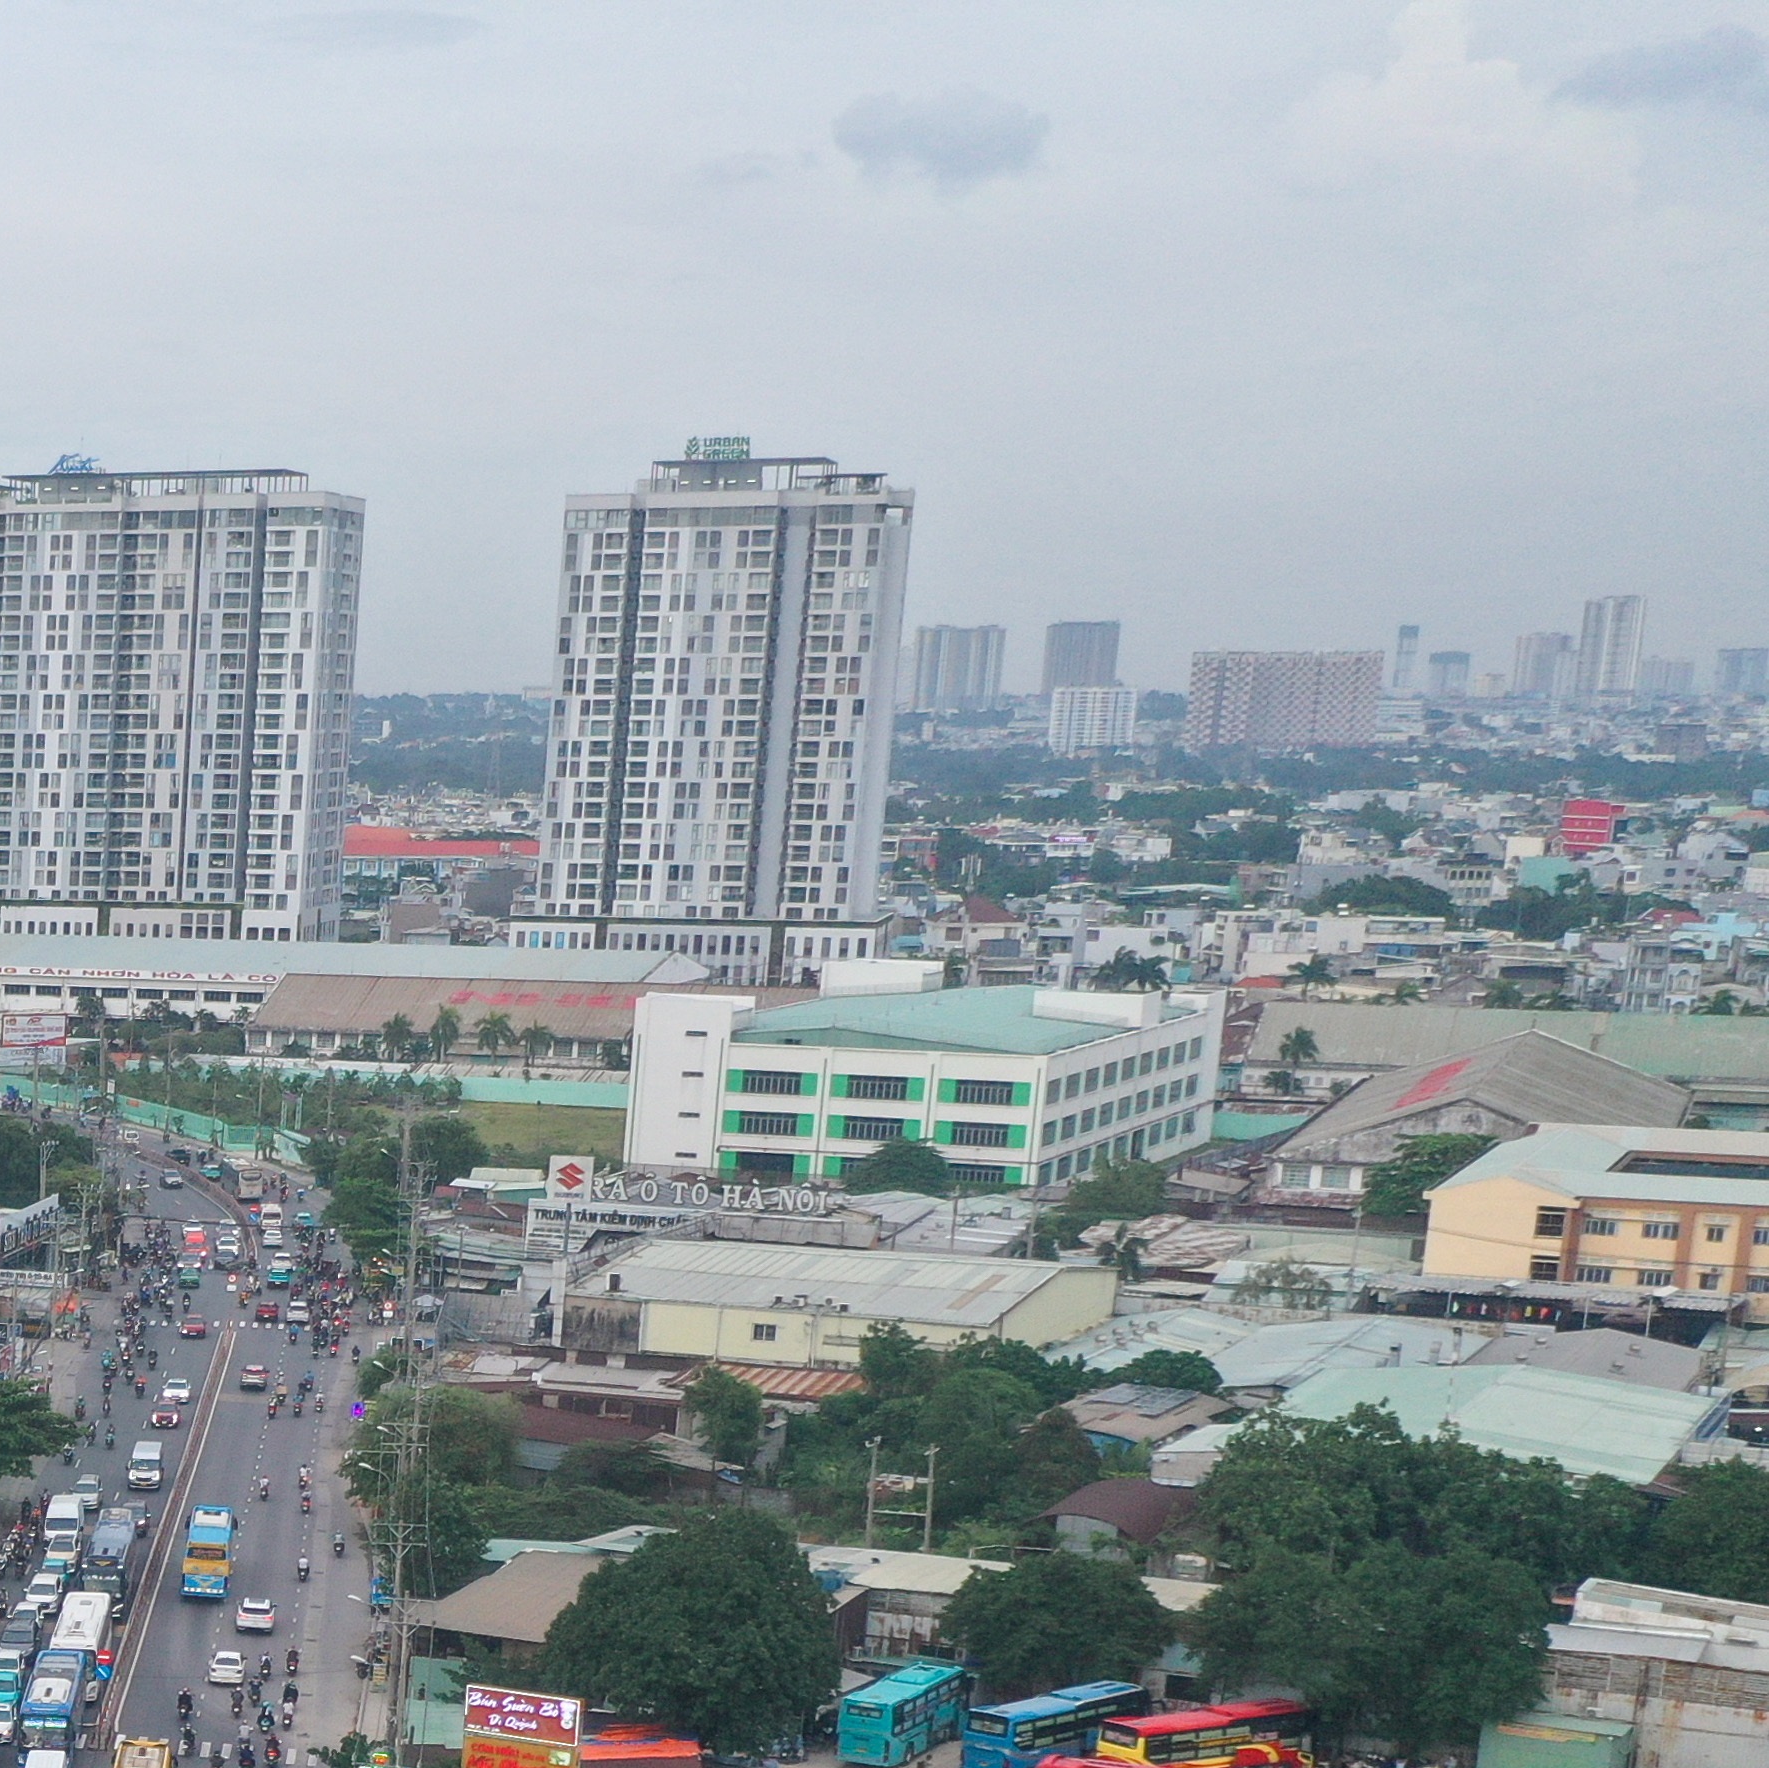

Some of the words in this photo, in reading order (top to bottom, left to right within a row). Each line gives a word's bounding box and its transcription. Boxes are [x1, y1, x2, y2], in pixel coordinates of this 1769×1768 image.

[29, 967, 70, 976] CÂN
[82, 969, 140, 978] NHƠN
[640, 1171, 658, 1201] Ô
[671, 1175, 709, 1205] TÔ
[721, 1178, 764, 1210] HÀ
[469, 1691, 498, 1709] Bún
[538, 1702, 560, 1718] Bò
